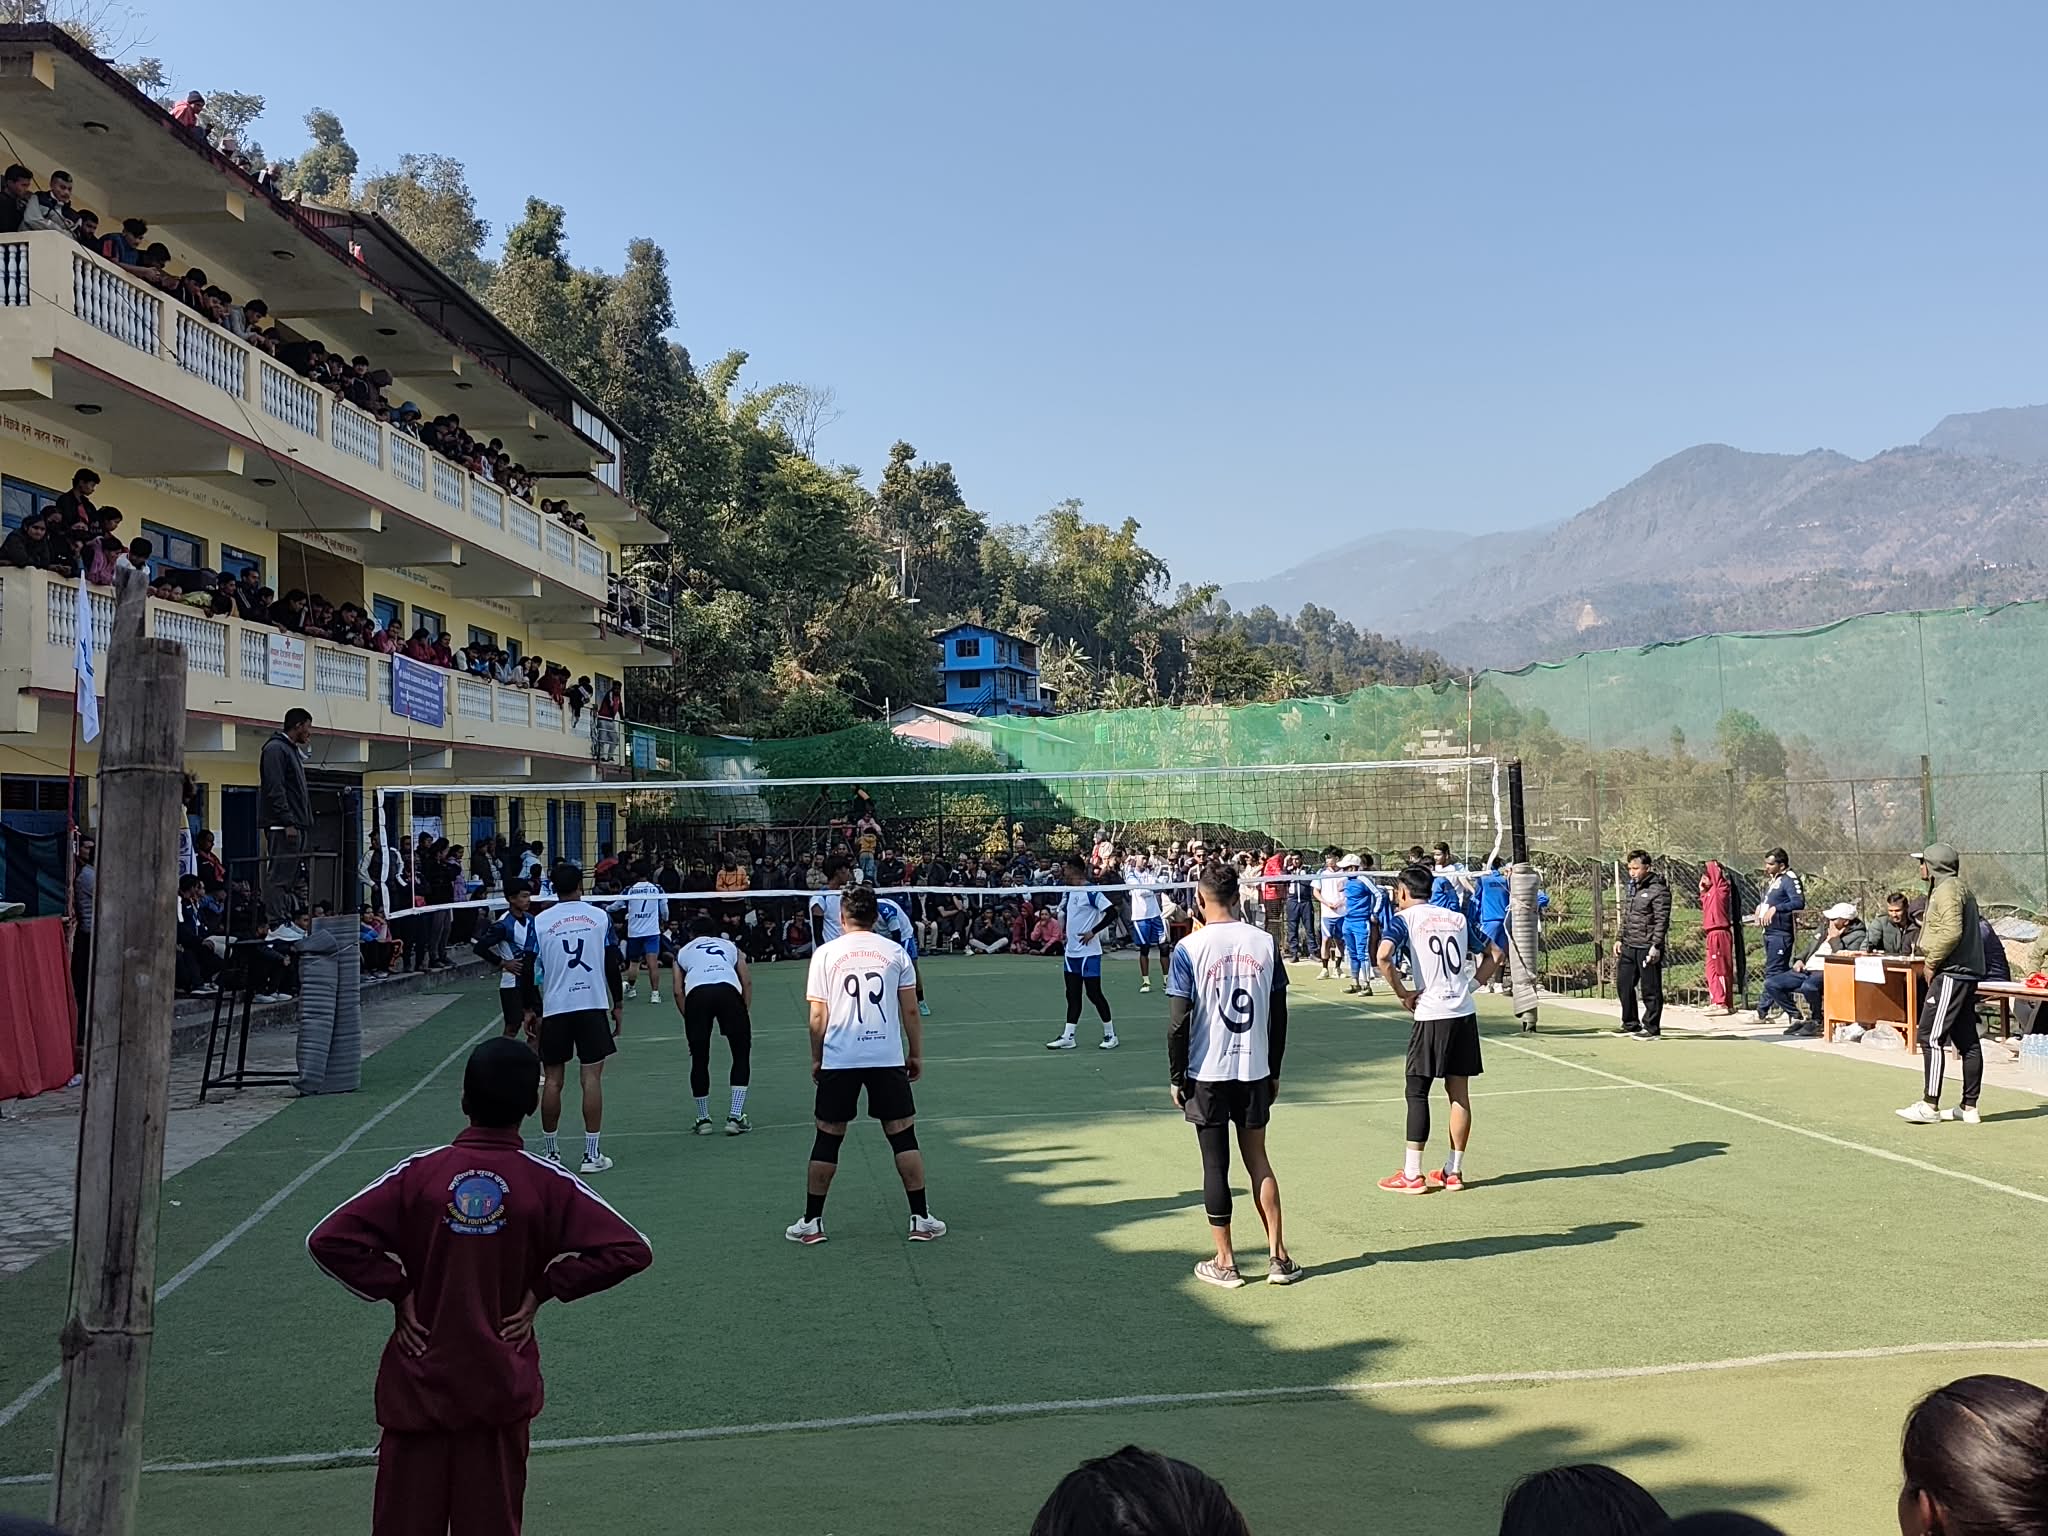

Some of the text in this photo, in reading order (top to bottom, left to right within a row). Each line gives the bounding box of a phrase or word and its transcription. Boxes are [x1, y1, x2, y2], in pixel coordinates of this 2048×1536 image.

[562, 938, 593, 972] ५
[1429, 935, 1462, 980] १०
[843, 971, 887, 1024] १२
[1216, 987, 1255, 1034] ७
[467, 1216, 488, 1225] YOUTH
[487, 1204, 505, 1222] GROUP
